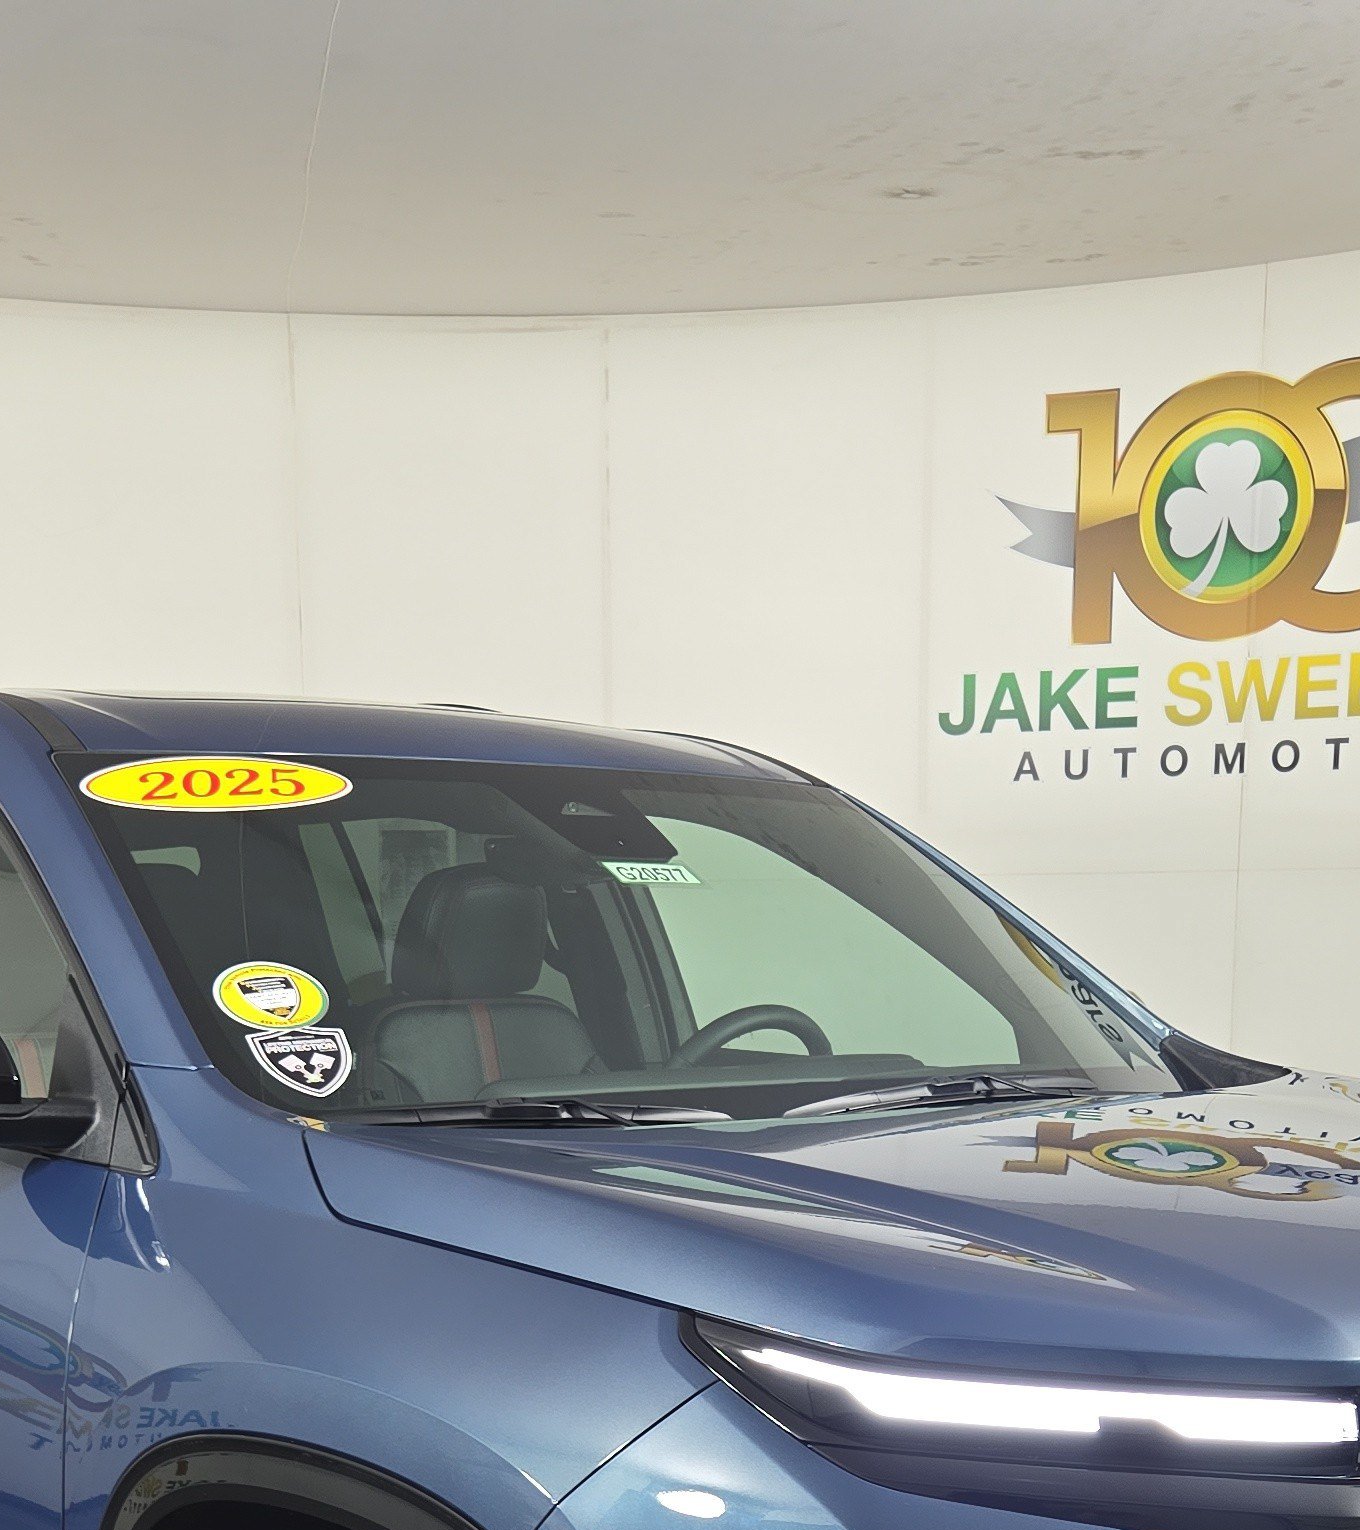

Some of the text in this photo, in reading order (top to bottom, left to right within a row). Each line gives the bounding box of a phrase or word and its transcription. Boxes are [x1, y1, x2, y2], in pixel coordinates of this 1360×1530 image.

[938, 665, 1139, 736] JAKE
[139, 768, 306, 800] 2025
[616, 867, 689, 882] G20577
